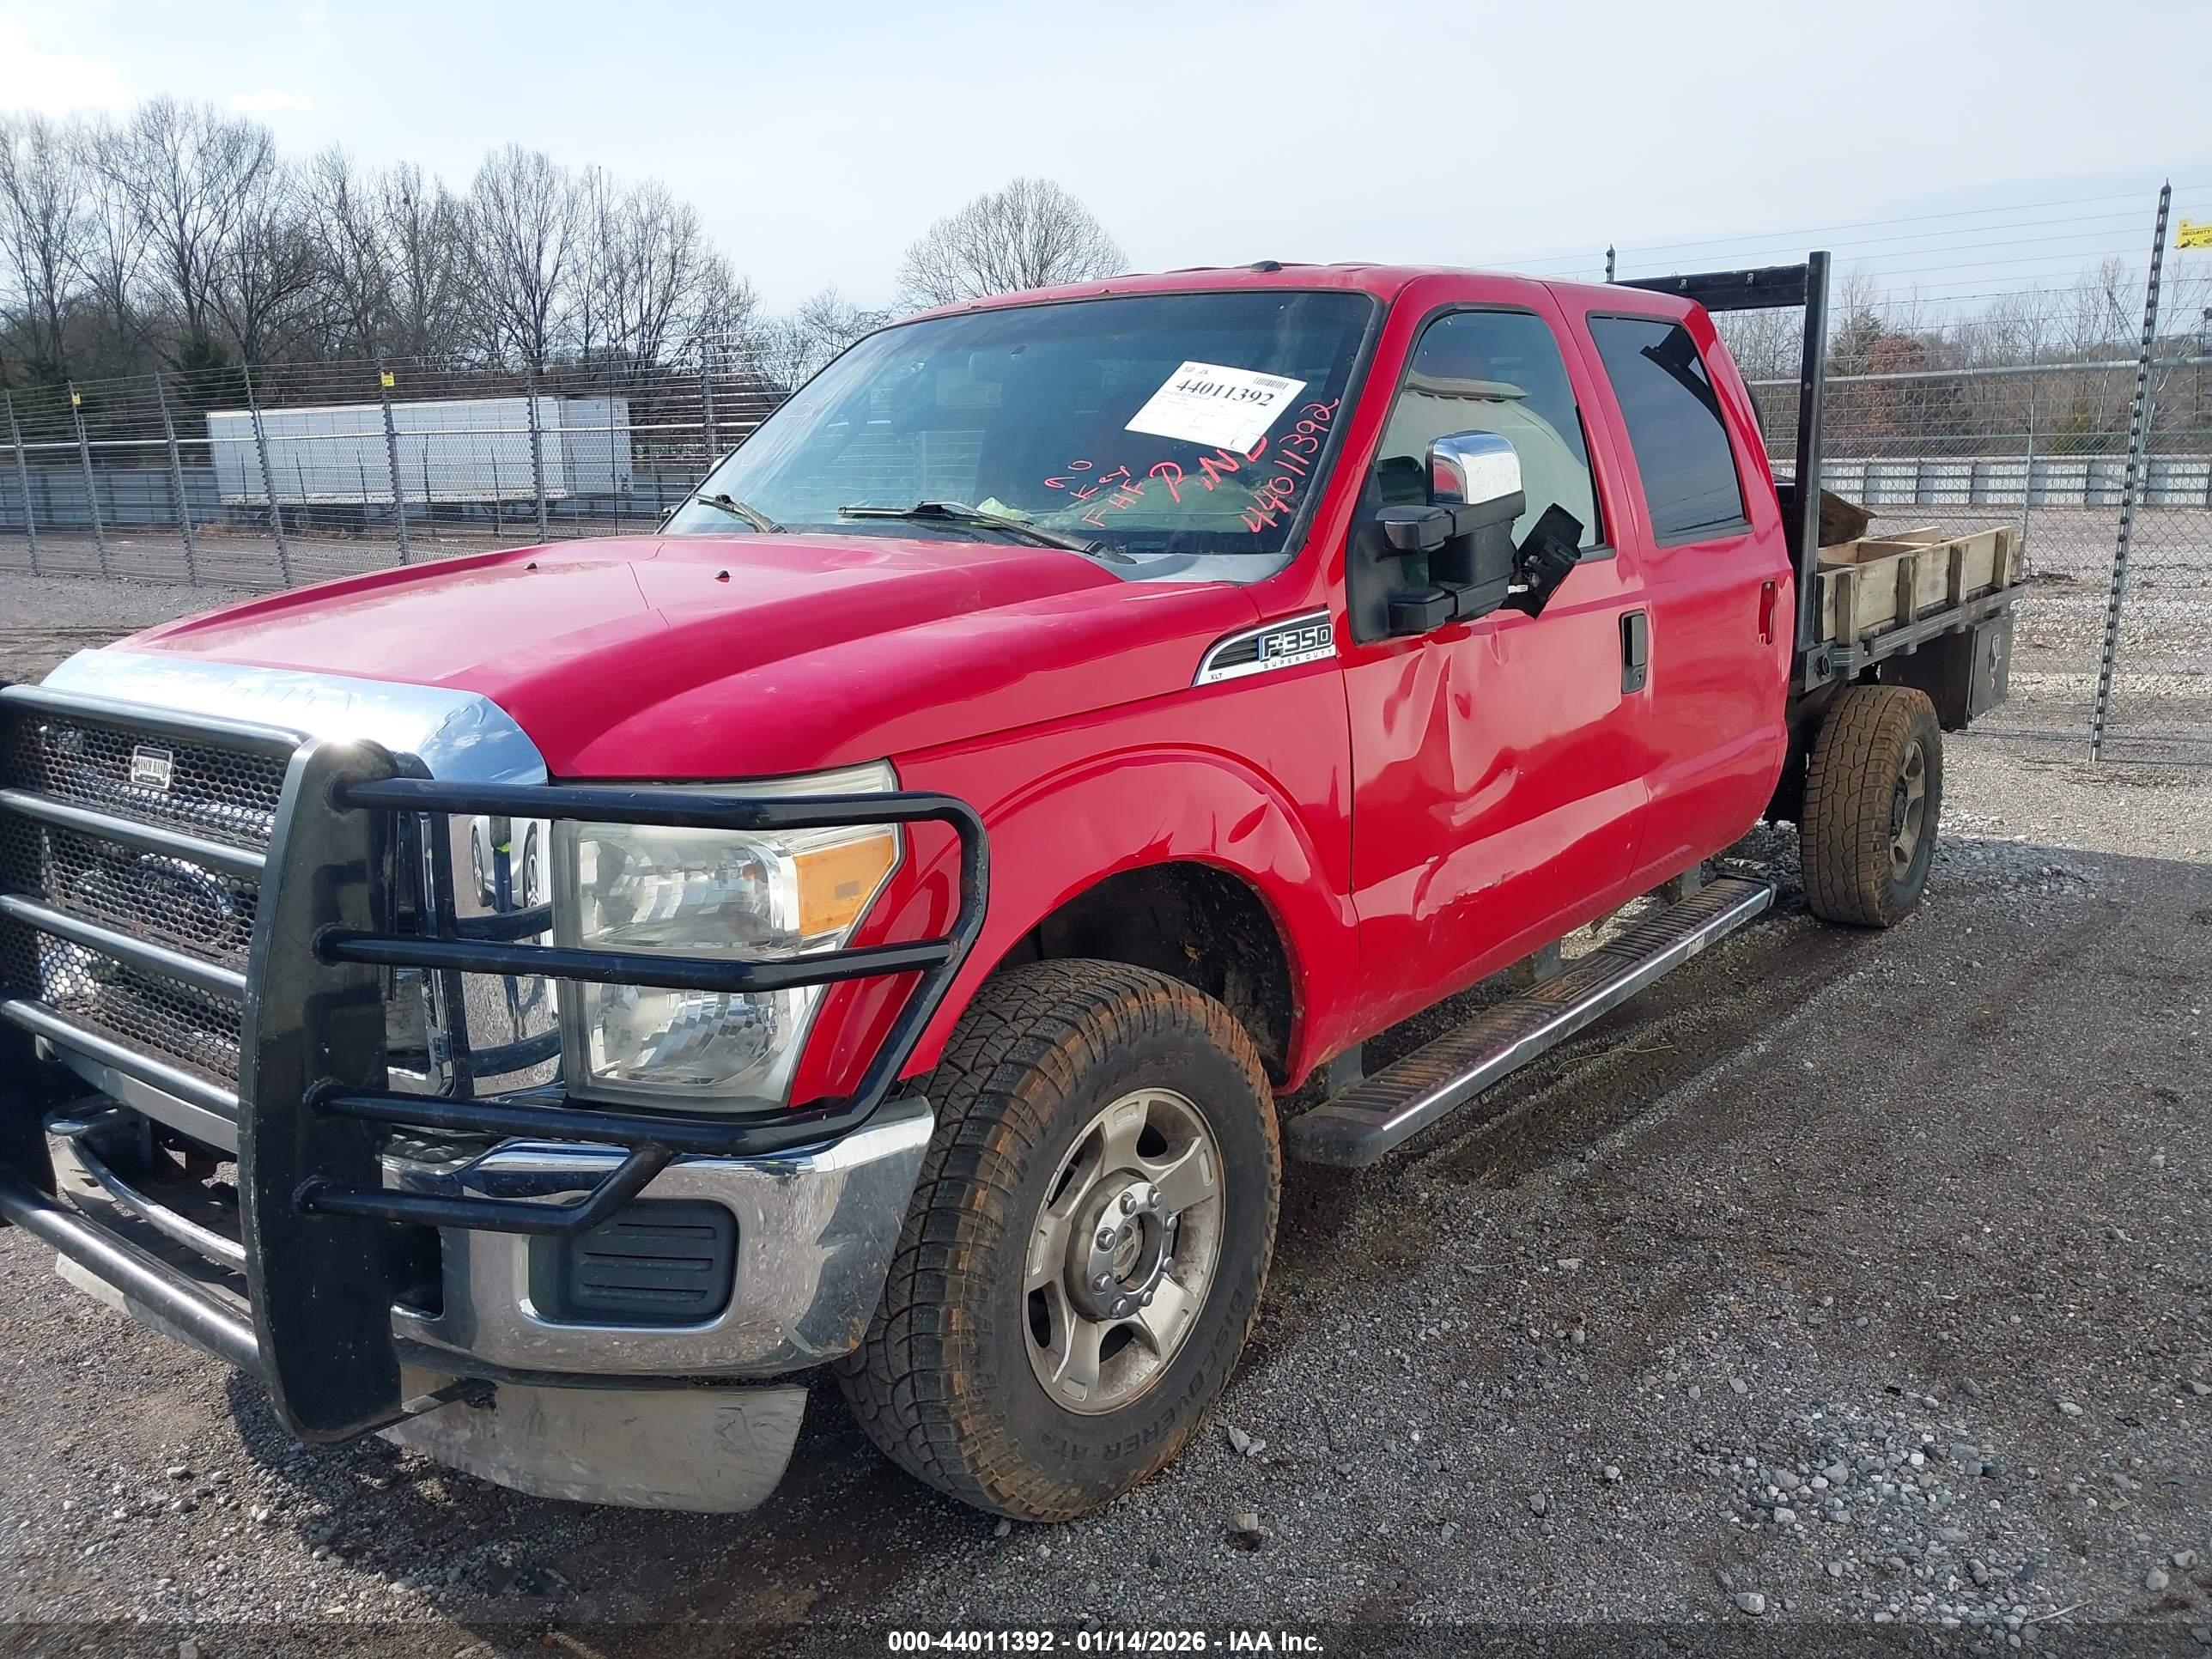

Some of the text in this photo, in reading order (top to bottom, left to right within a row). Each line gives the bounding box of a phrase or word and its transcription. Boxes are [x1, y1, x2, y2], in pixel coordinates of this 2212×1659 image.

[1176, 379, 1274, 406] 44011392
[1241, 398, 1340, 533] 44011392
[1263, 648, 1333, 670] SUPER DUTY
